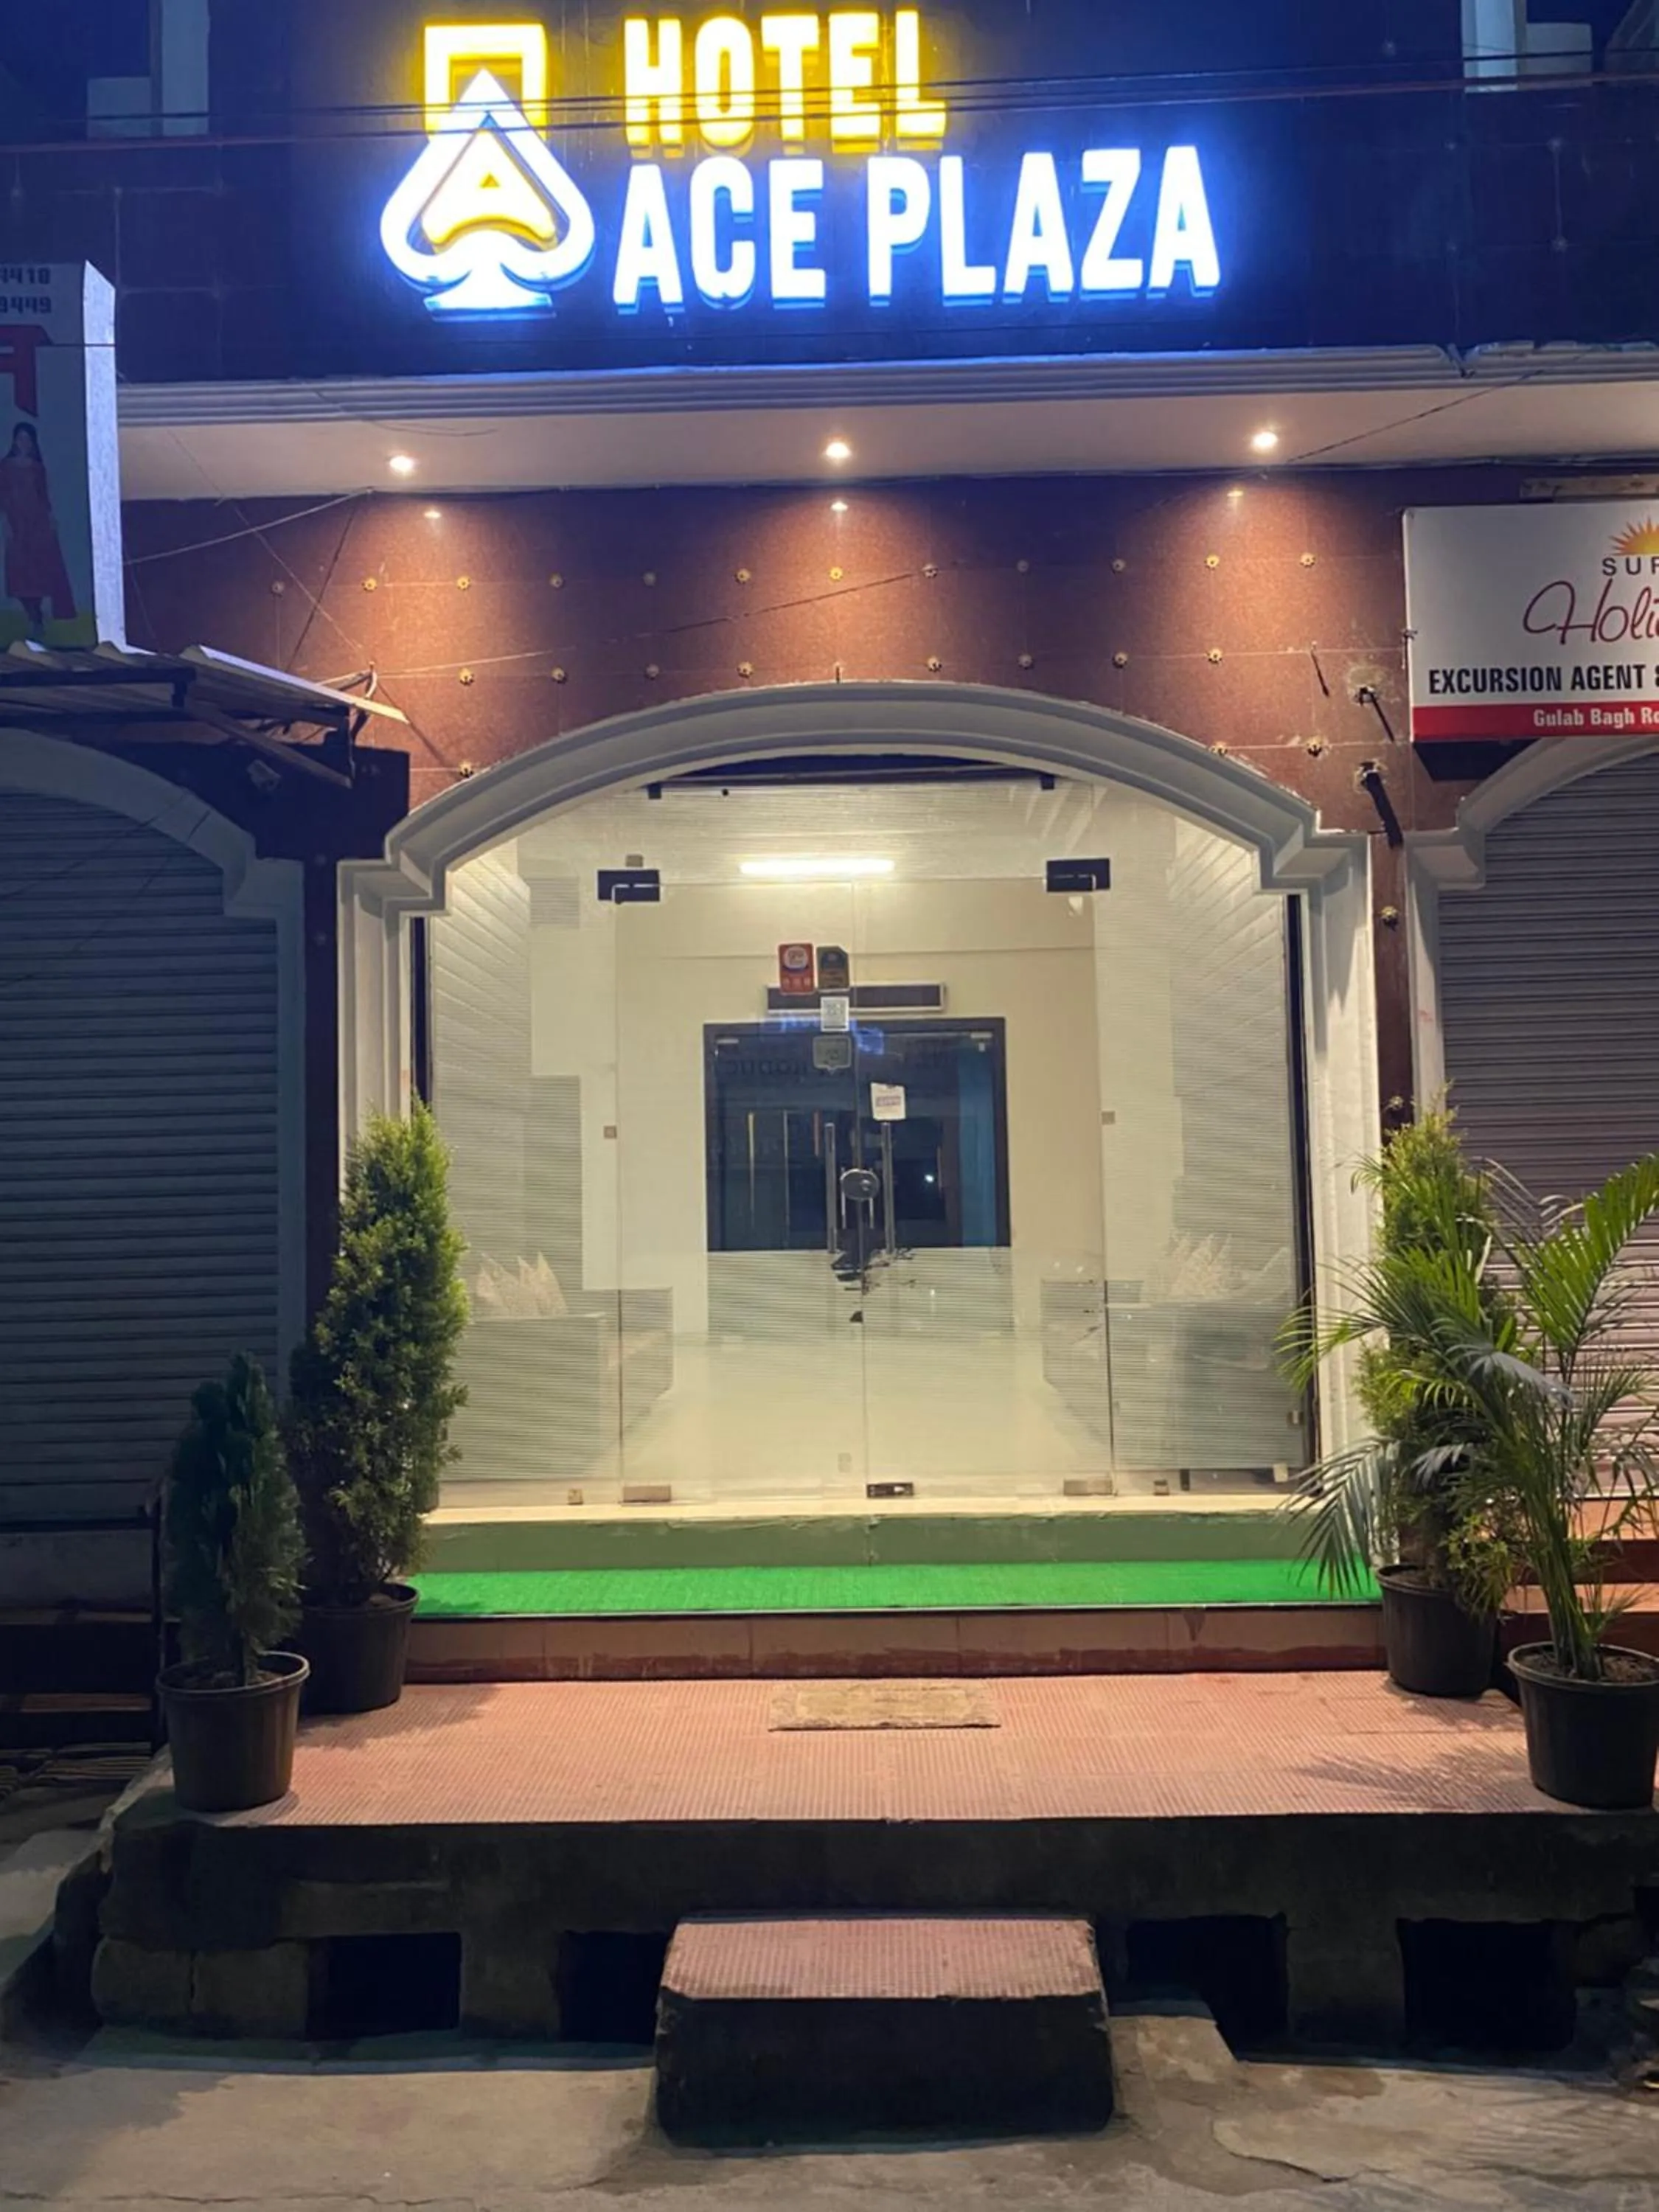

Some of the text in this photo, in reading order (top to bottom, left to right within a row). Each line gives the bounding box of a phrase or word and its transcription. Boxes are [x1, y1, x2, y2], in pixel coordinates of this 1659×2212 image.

[624, 10, 947, 152] HOTEL
[612, 145, 1222, 313] ACE PLAZA
[1523, 578, 1659, 645] Holi
[1429, 667, 1562, 694] EXCURSION
[1570, 664, 1646, 689] AGENT
[1534, 708, 1584, 726] Gulab
[1590, 707, 1635, 728] Bagh
